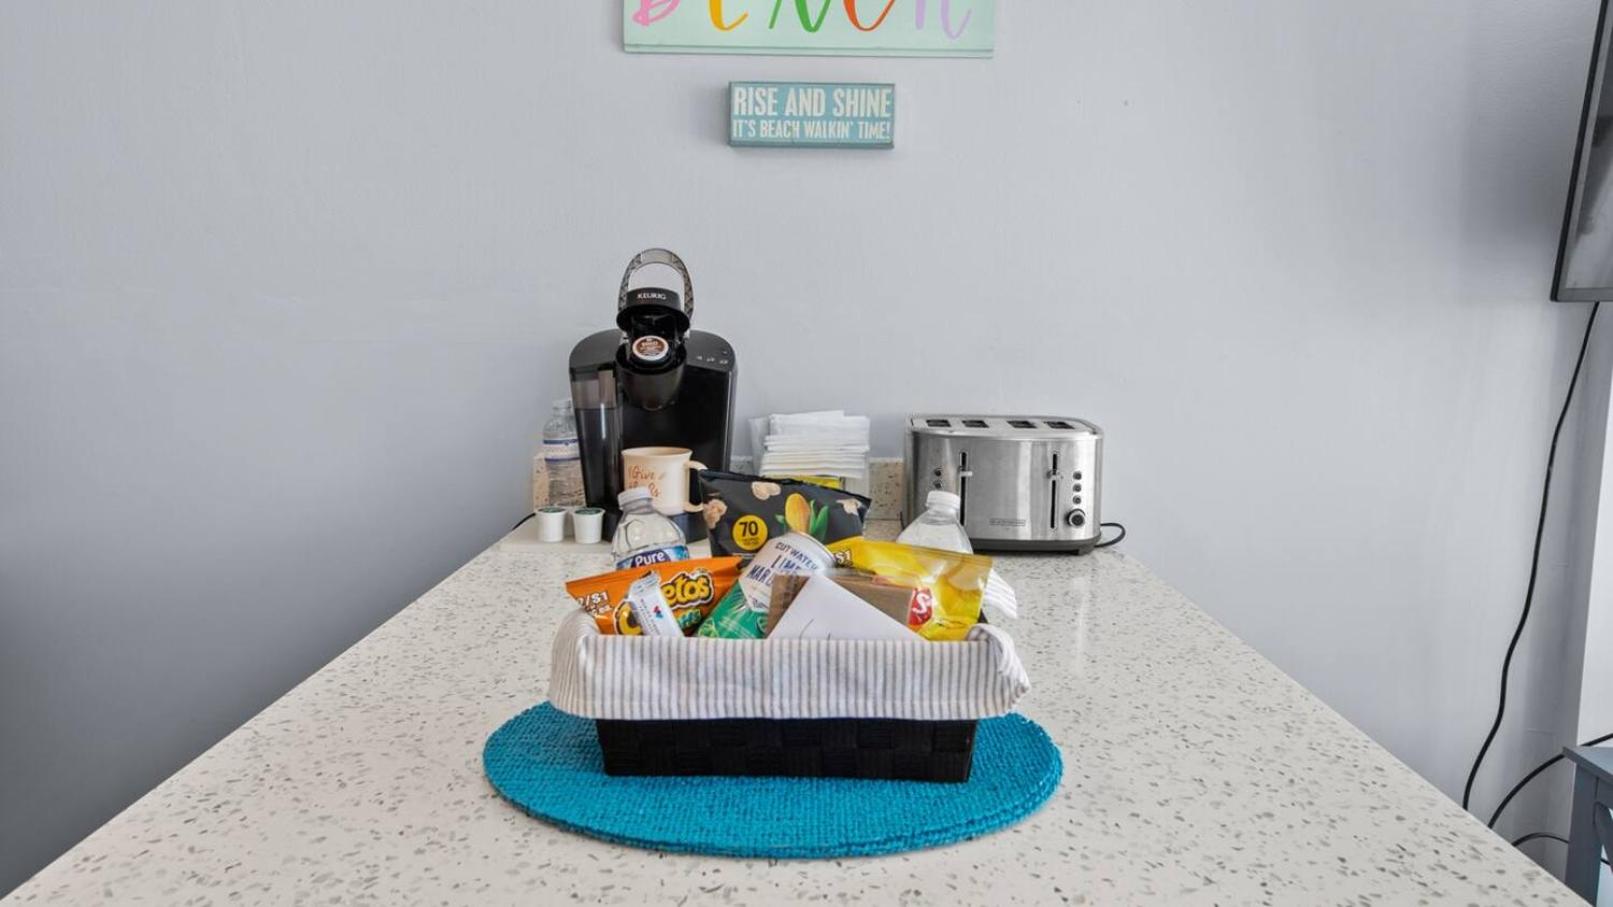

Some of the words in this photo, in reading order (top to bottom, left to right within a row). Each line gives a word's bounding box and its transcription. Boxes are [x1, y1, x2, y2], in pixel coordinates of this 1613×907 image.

[733, 86, 778, 116] RISE
[785, 87, 825, 117] AND
[832, 88, 892, 118] SHINE
[732, 119, 756, 138] IT'S
[759, 119, 800, 139] BEACH
[804, 120, 853, 139] WALKIN'
[858, 121, 891, 140] TIME!
[637, 292, 667, 300] KEURIG
[739, 521, 758, 537] 70
[635, 552, 665, 568] Pure
